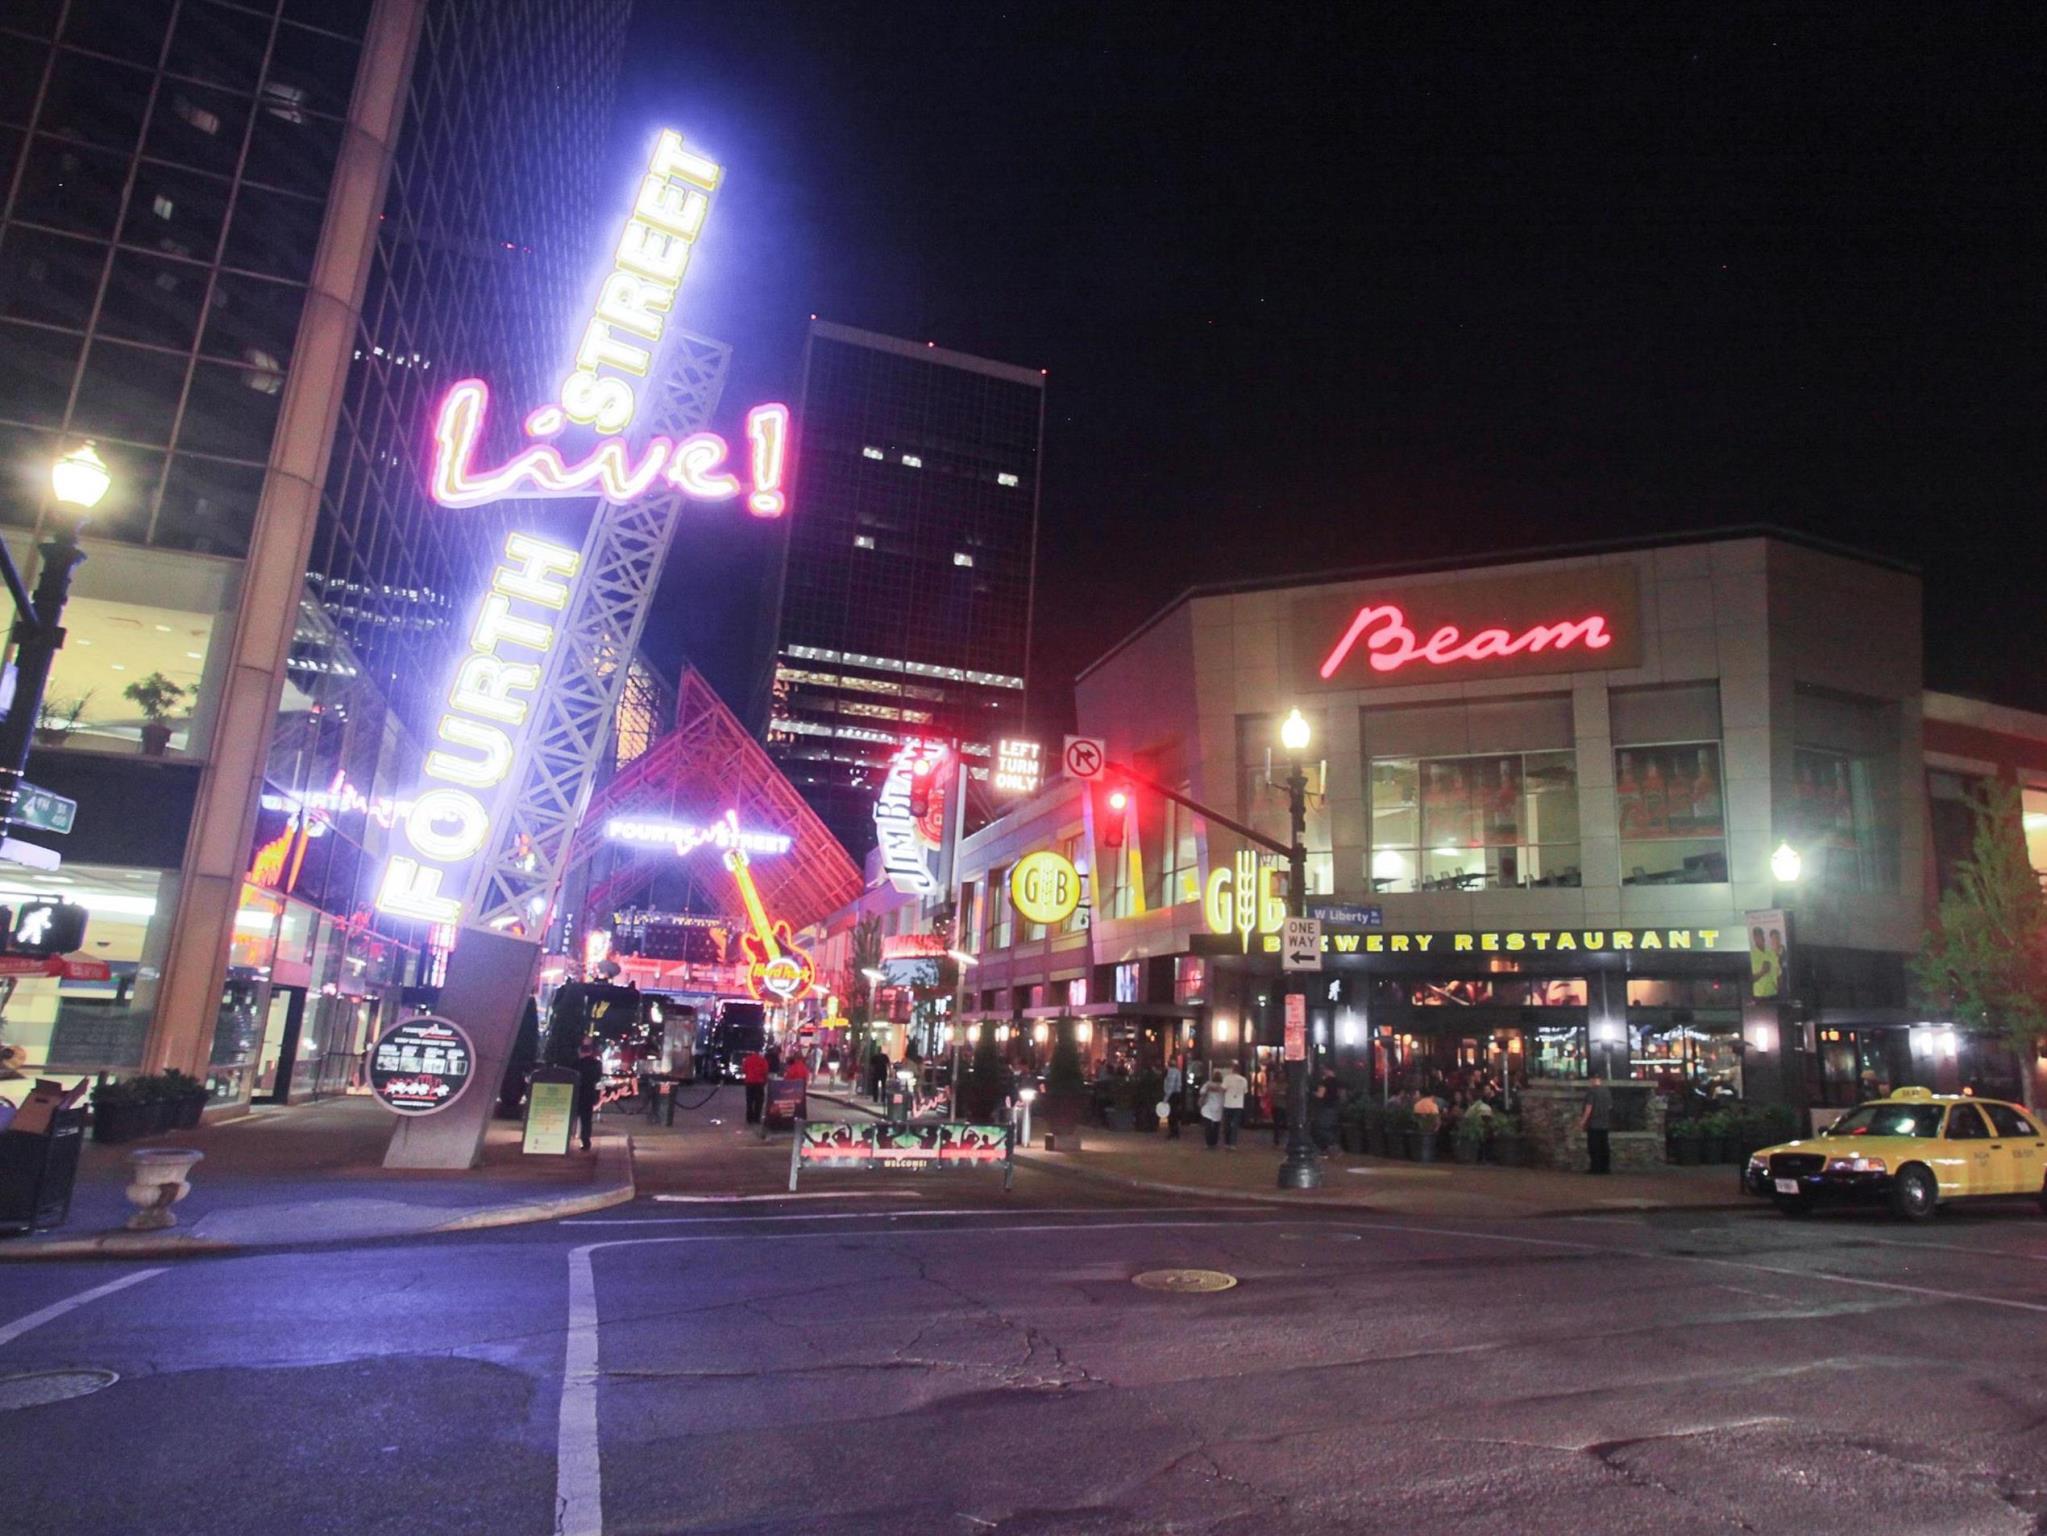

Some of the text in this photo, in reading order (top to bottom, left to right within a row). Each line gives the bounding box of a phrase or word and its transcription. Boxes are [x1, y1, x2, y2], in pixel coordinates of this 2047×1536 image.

[561, 128, 721, 434] STREET
[434, 378, 789, 517] Live!
[1320, 605, 1611, 678] Beam
[375, 532, 581, 925] FOURTH
[1000, 739, 1040, 758] LEFT
[999, 758, 1039, 774] TURN
[996, 774, 1039, 791] ONLY
[884, 830, 930, 887] JIM
[1289, 921, 1315, 934] ONE
[1314, 909, 1327, 923] W
[1329, 909, 1369, 930] Liberty
[1263, 930, 1719, 952] BWERY RESTAURANT
[1289, 935, 1317, 948] WAY
